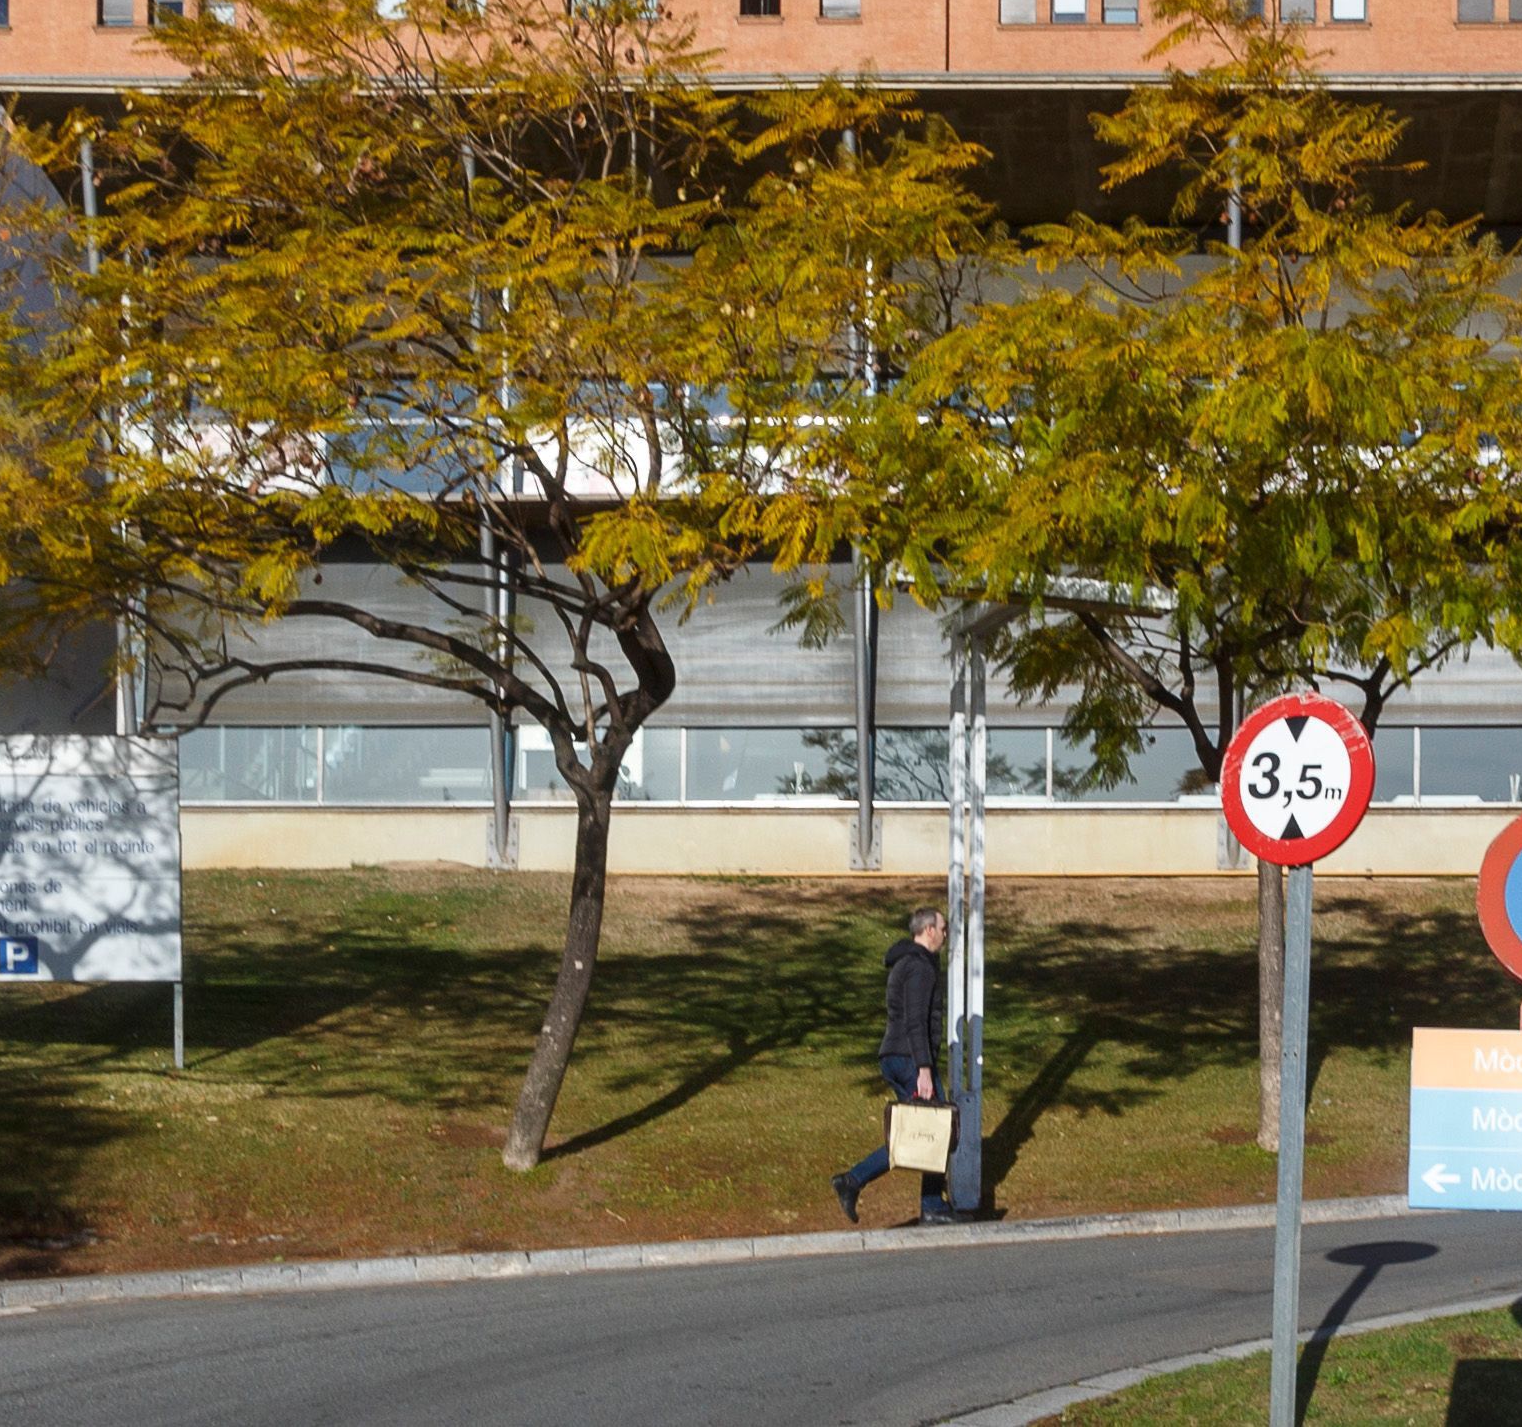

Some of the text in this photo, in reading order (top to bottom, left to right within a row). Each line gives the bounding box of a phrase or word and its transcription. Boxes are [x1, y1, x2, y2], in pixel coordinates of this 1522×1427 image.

[42, 797, 62, 813] de
[68, 798, 130, 814] vehicles
[136, 802, 147, 814] a
[31, 840, 51, 853] en
[58, 838, 78, 853] tot
[84, 837, 98, 853] el
[104, 838, 155, 854] recinte
[43, 878, 63, 894] de
[15, 920, 72, 936] prohibit
[79, 922, 97, 934] en
